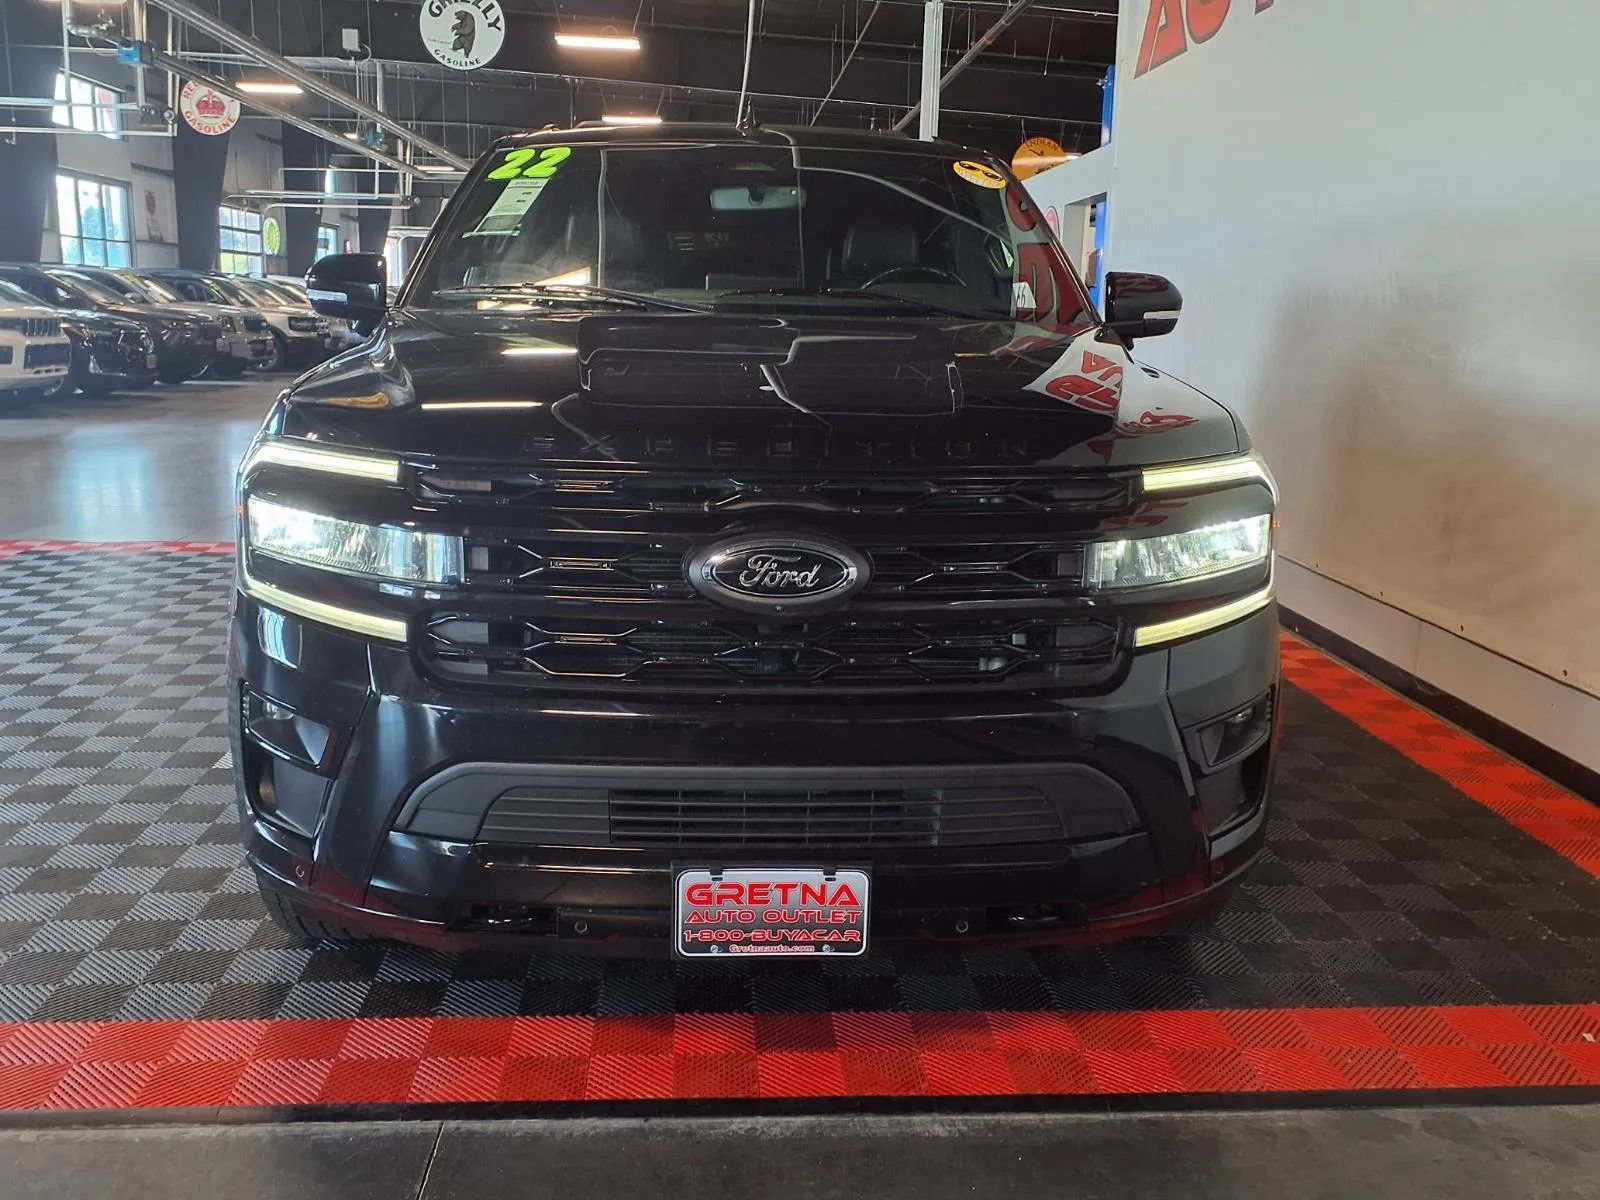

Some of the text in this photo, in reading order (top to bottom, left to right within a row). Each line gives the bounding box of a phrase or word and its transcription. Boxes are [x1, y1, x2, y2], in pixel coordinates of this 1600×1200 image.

[428, 0, 501, 31] GZLY
[434, 48, 481, 67] GASOLINE
[183, 81, 200, 99] RE
[185, 110, 236, 133] GASOLINE
[1026, 138, 1058, 151] INDIAN
[487, 147, 572, 180] 22
[739, 554, 822, 588] Ford
[684, 882, 862, 907] GRETNA
[684, 909, 863, 924] AUTO OUTLET
[683, 929, 861, 942] 1-800-BUYACAR
